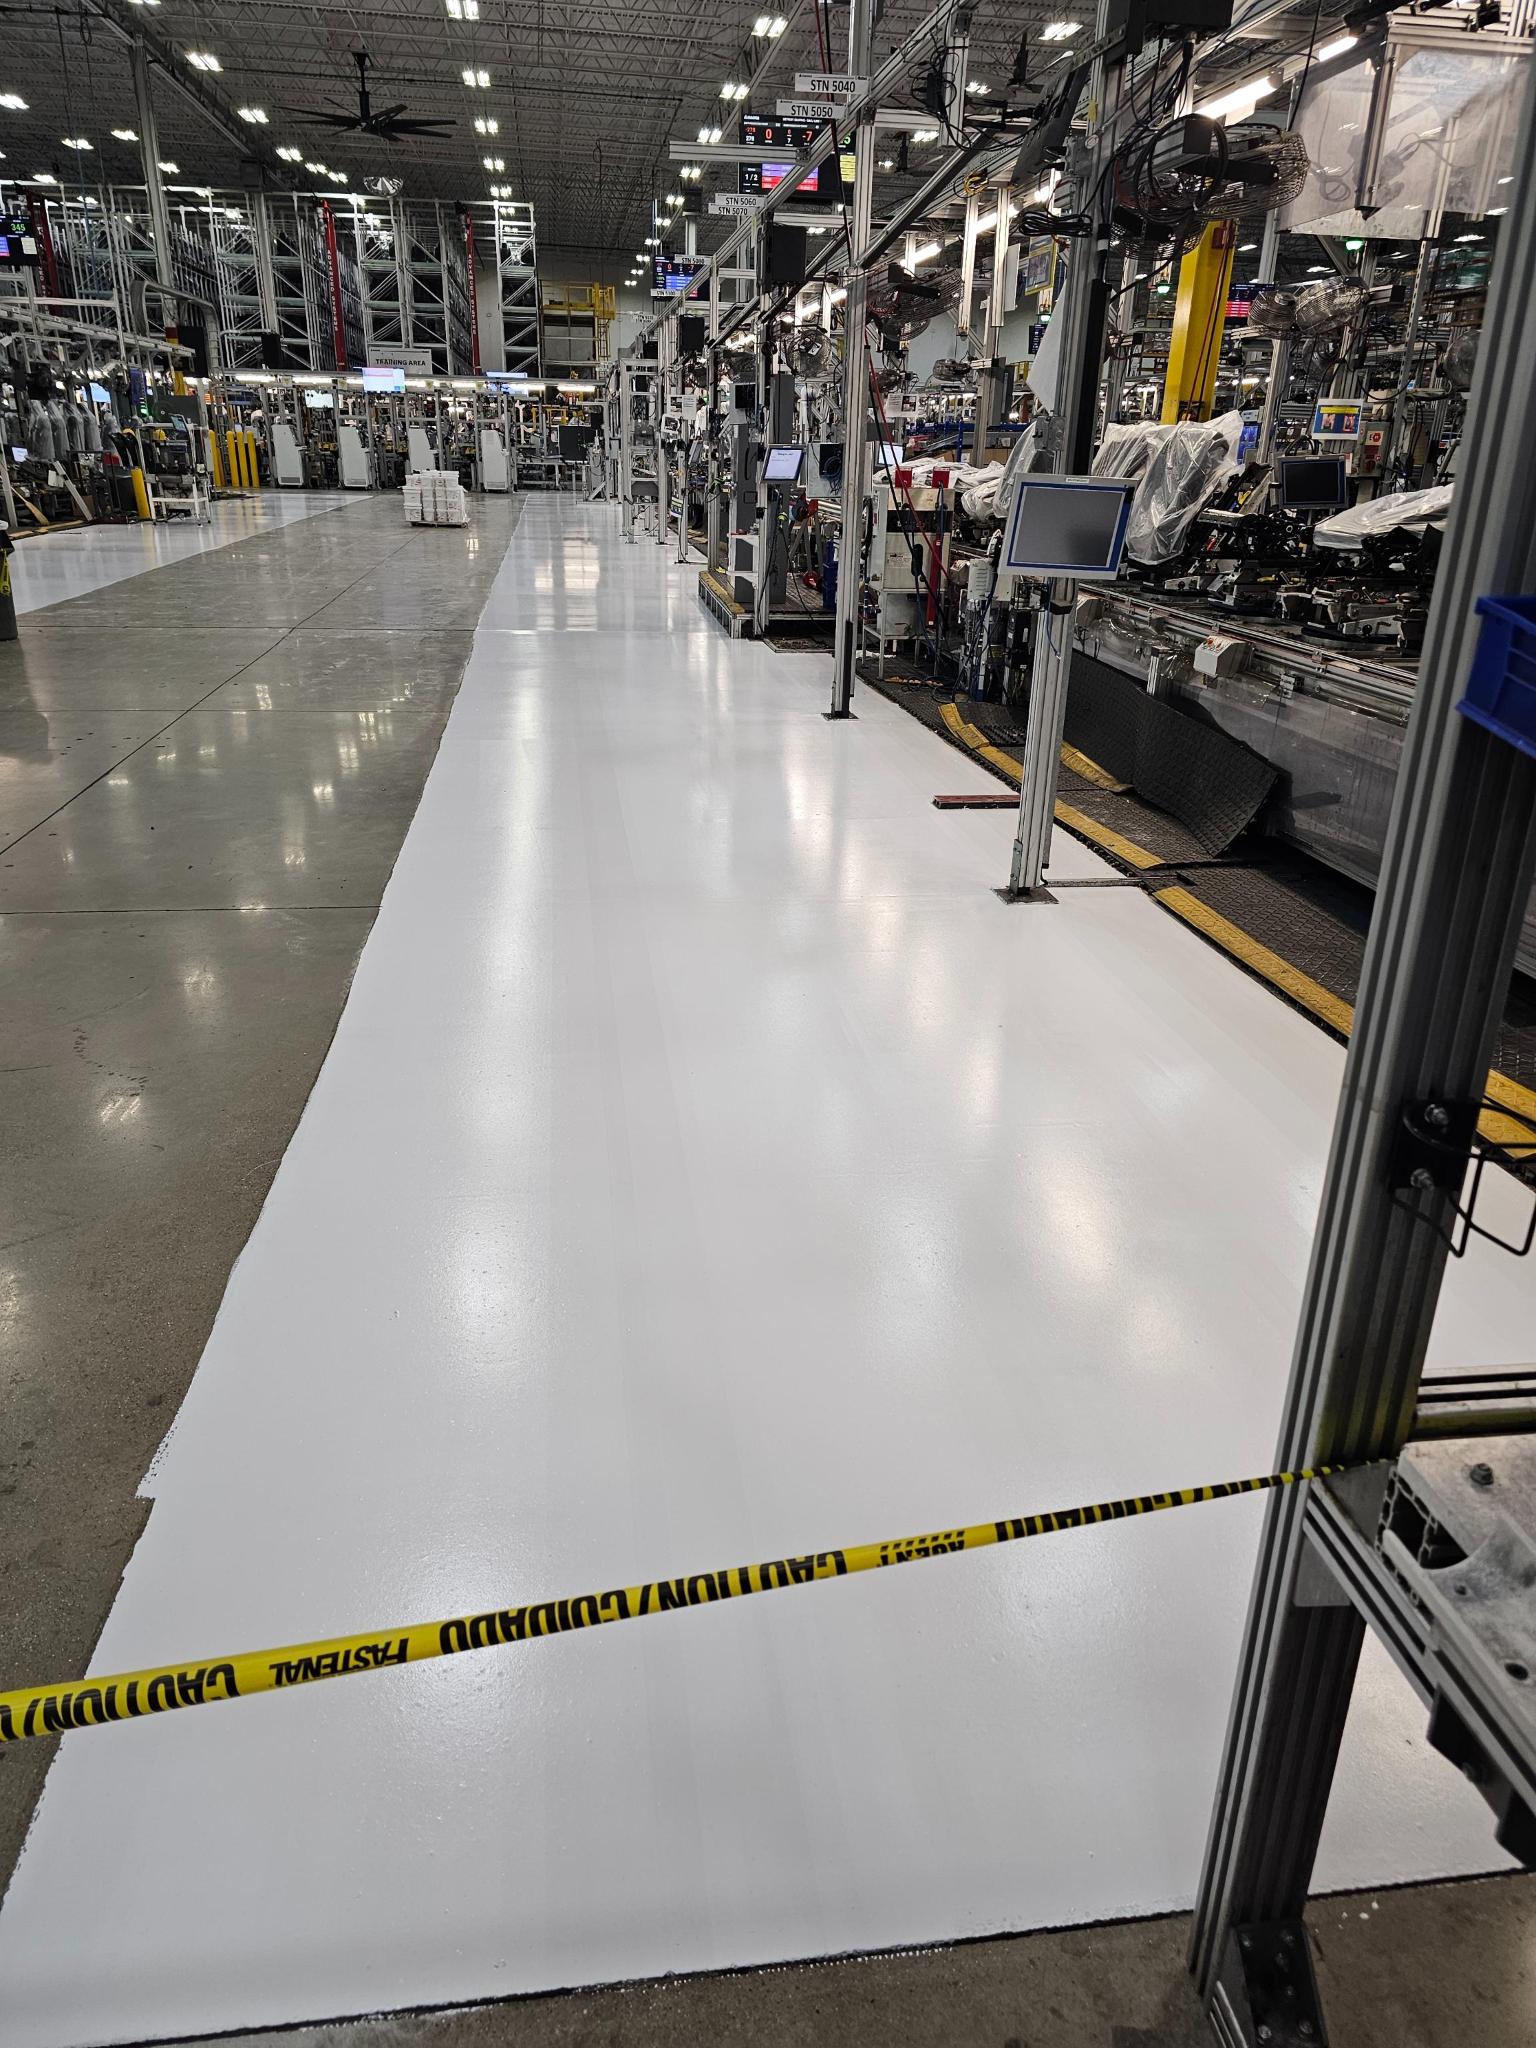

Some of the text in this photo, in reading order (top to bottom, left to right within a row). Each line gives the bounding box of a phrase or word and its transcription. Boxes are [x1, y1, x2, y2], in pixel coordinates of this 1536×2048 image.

[811, 79, 856, 92] STN 5040
[791, 105, 833, 117] STN 5050
[765, 128, 772, 139] 0
[802, 130, 812, 141] -7
[726, 197, 756, 206] STN 5060
[718, 206, 747, 215] STN 5070
[10, 223, 26, 232] 345
[327, 249, 339, 332] ADVANCED SYSTEMS
[375, 358, 407, 366] TRAINING
[269, 1637, 410, 1686] FASTENAL
